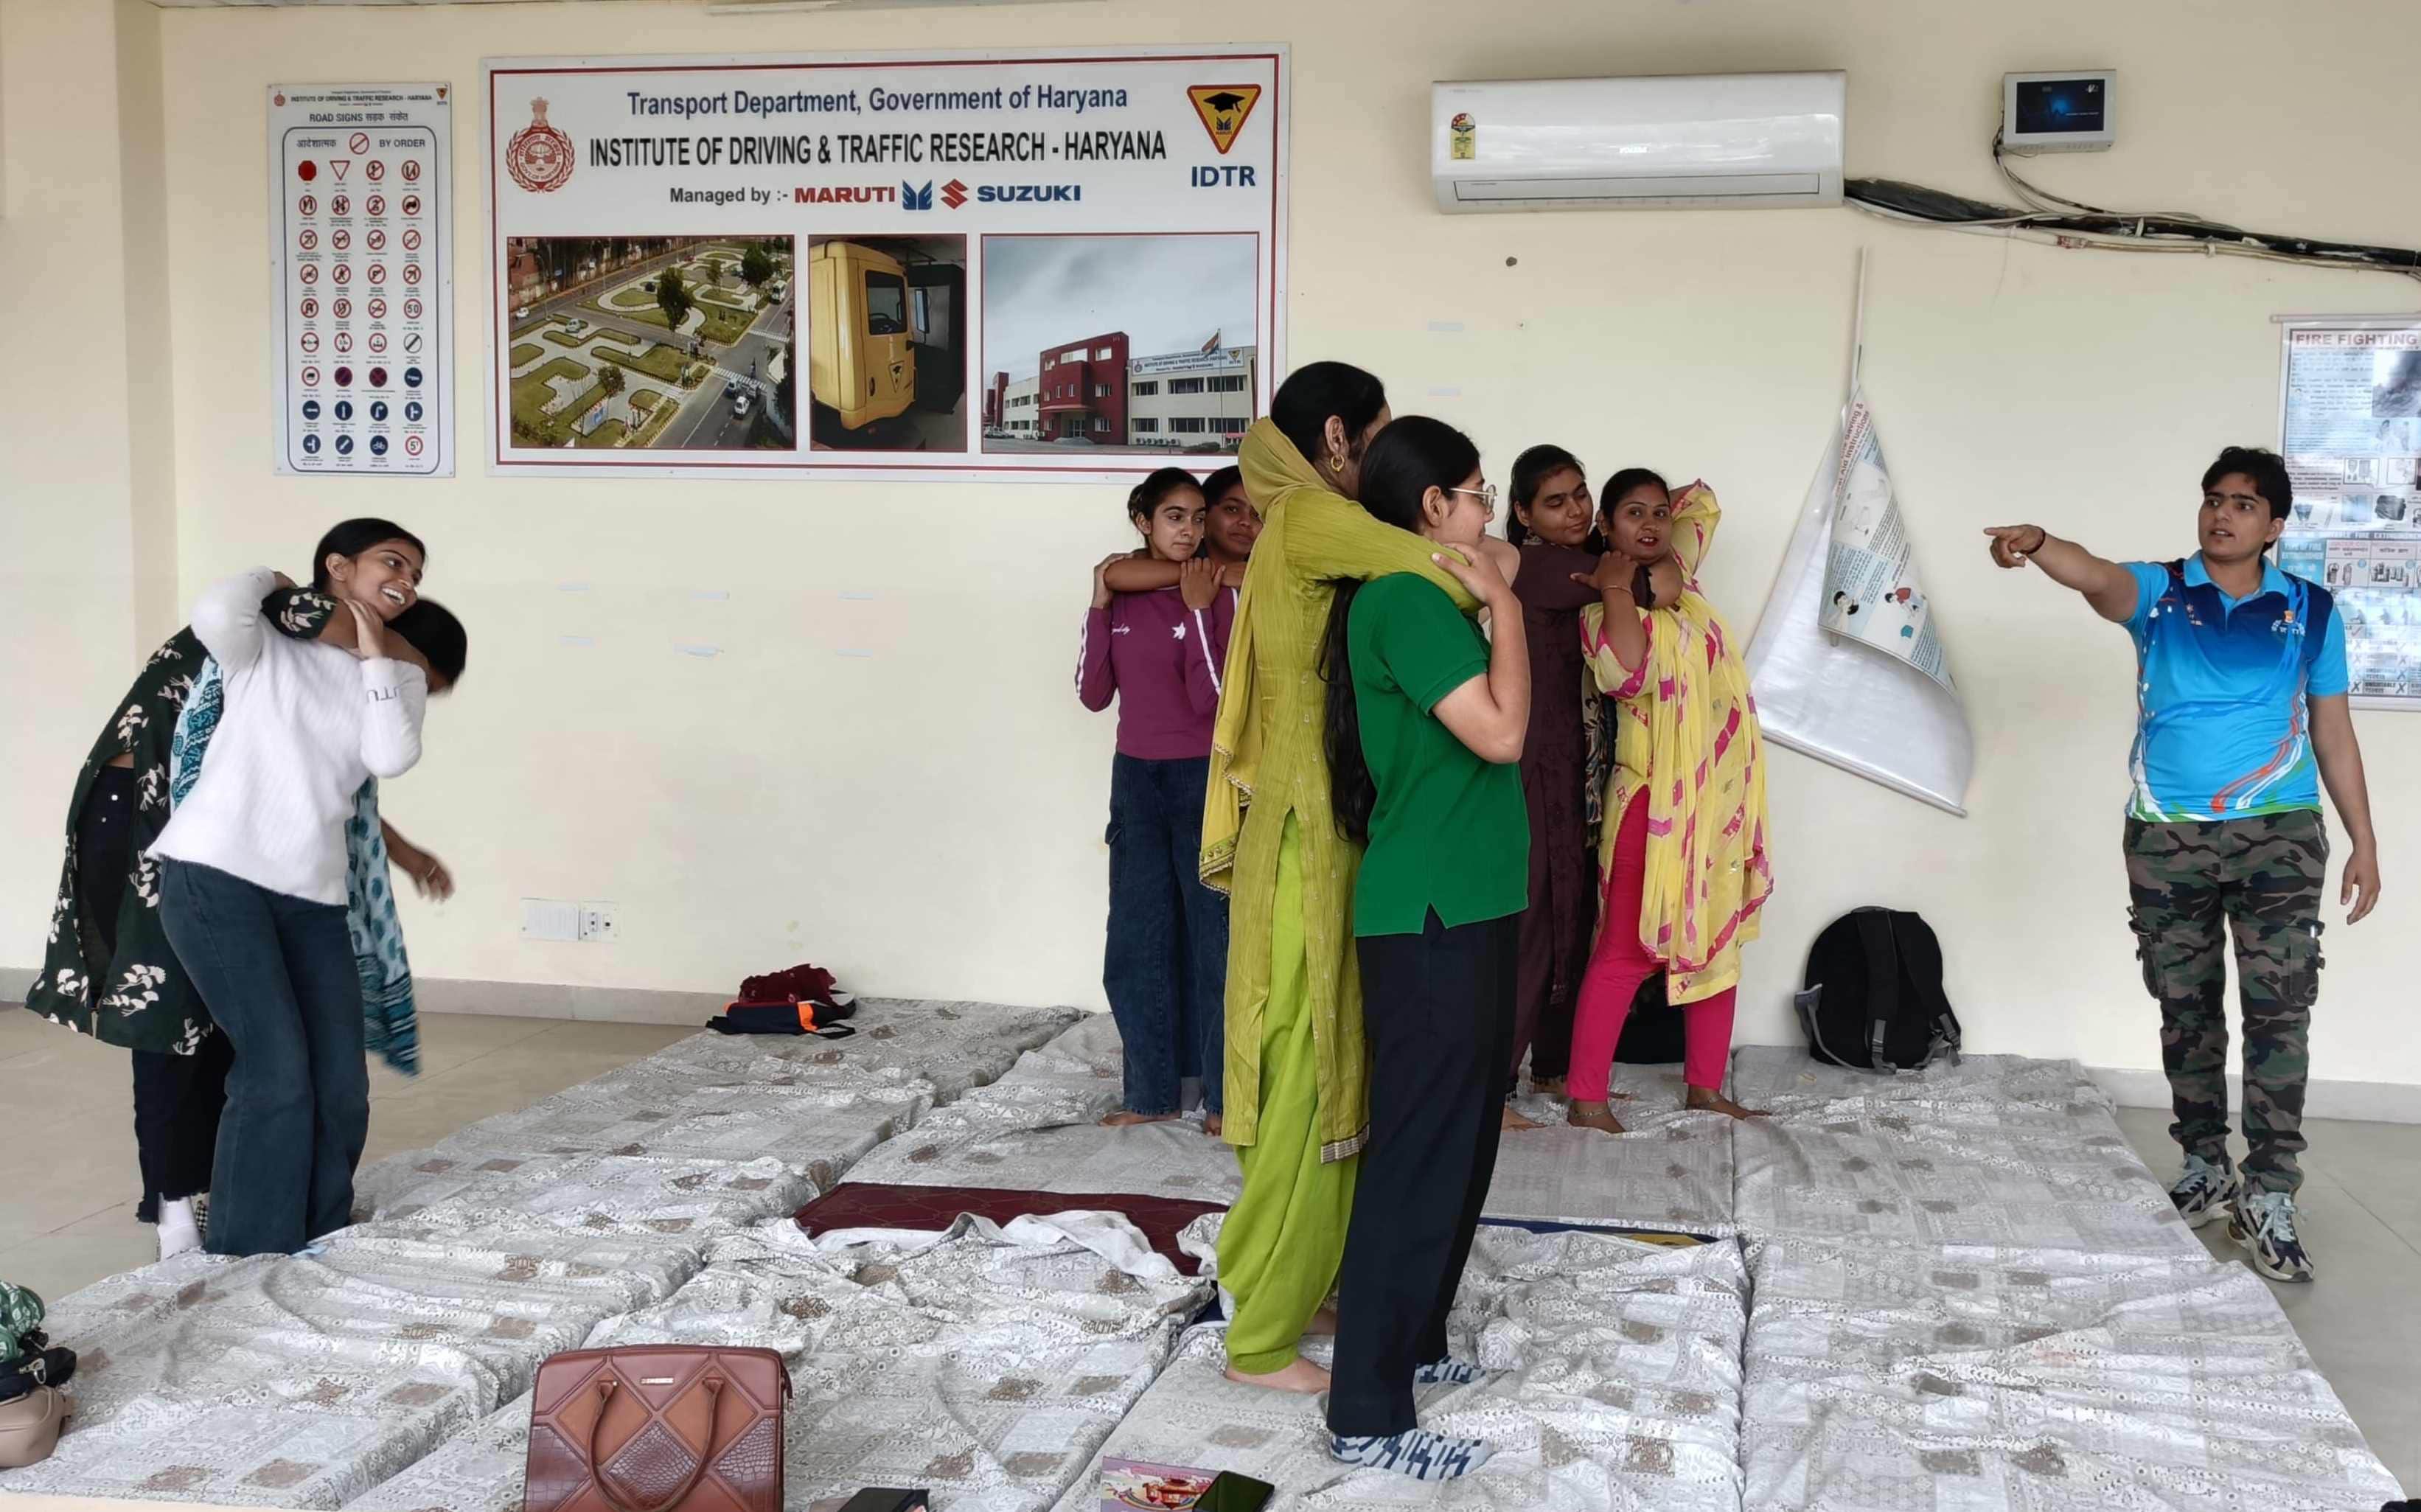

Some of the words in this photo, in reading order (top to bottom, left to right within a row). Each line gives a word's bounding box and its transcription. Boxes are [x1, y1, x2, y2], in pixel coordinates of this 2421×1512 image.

[627, 92, 728, 120] Transport
[734, 90, 861, 119] Department,
[869, 86, 1002, 111] Government
[1009, 85, 1031, 109] of
[1038, 84, 1127, 114] Haryana
[309, 114, 334, 122] ROAD
[335, 113, 363, 122] SIGNS
[379, 139, 391, 147] BY
[394, 139, 425, 147] ORDER
[591, 137, 690, 167] INSTITUTE
[697, 137, 722, 166] OF
[730, 135, 811, 165] DRIVING
[818, 135, 832, 164] &
[837, 133, 923, 164] TRAFFIC
[930, 131, 1045, 163] RESEARCH
[1065, 130, 1167, 161] HARYANA
[1191, 166, 1256, 187] IDTR
[670, 187, 745, 206] Managed
[751, 187, 770, 205] by
[795, 186, 895, 203] MARUTI
[977, 184, 1081, 203] SUZUKI
[2296, 334, 2332, 345] FIRE
[2338, 333, 2417, 345] FIGHTING
